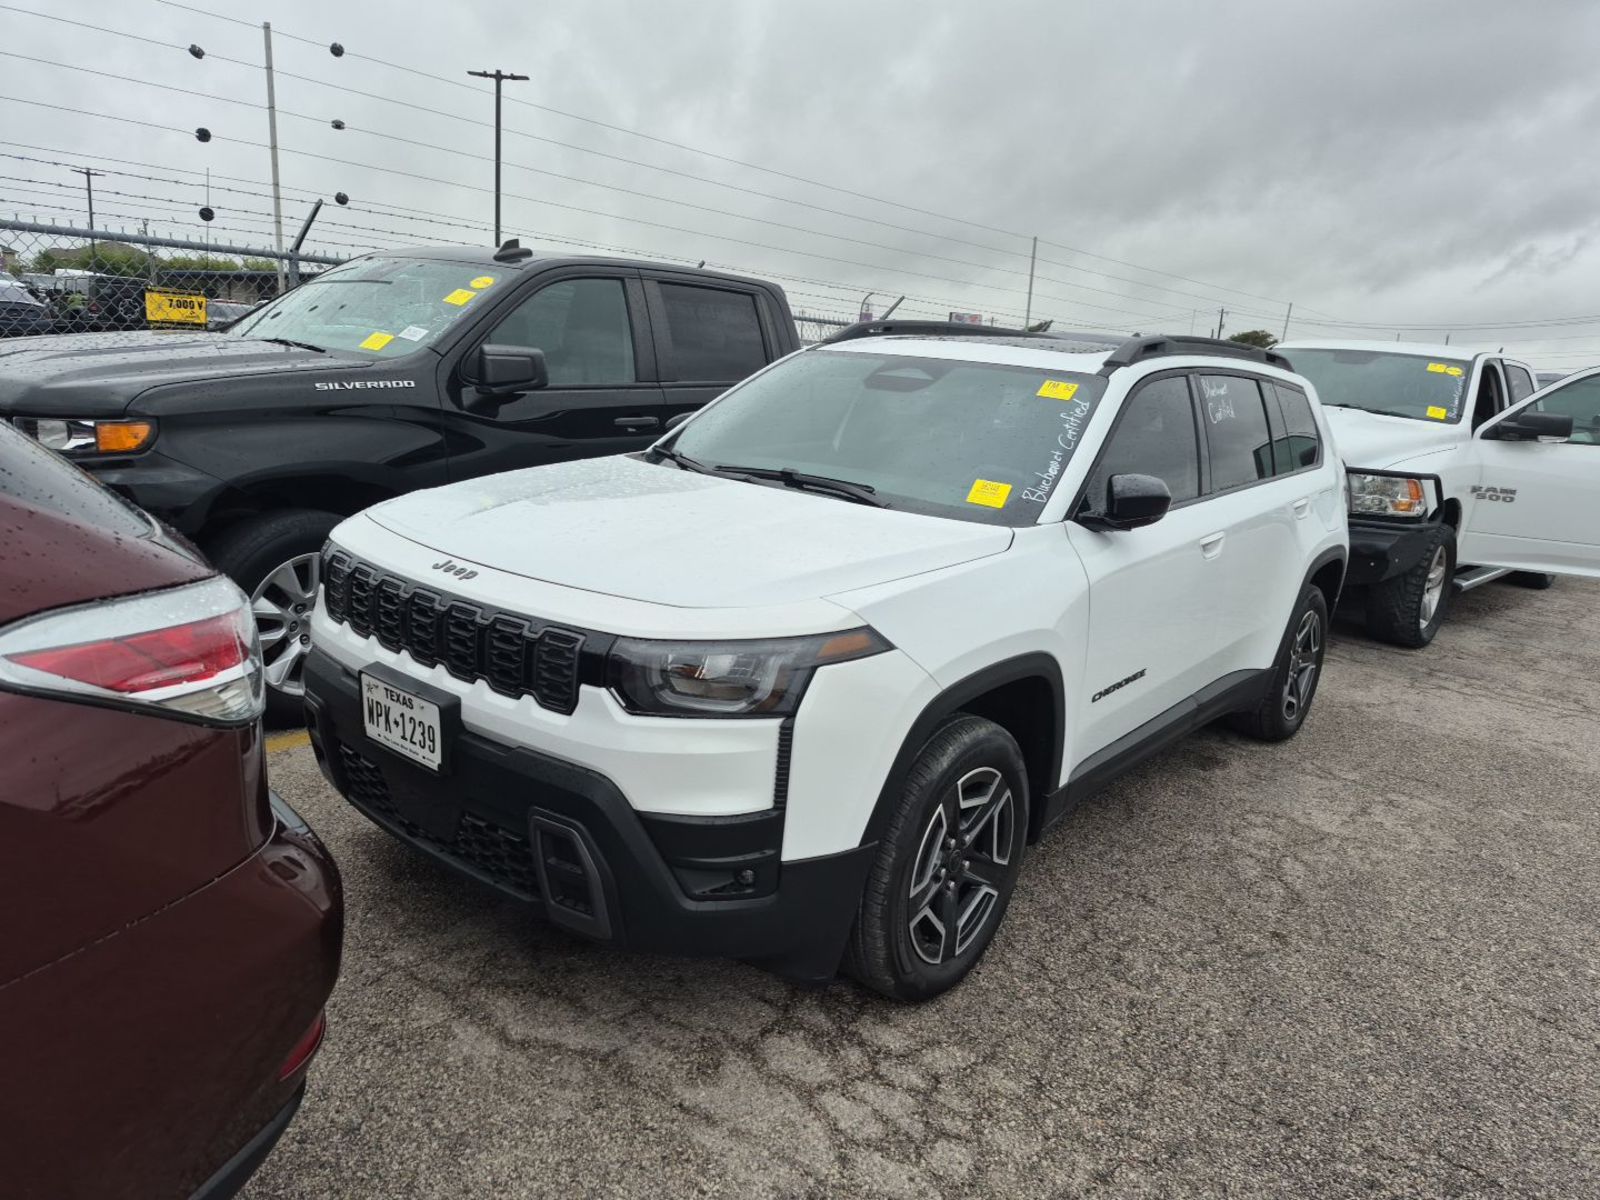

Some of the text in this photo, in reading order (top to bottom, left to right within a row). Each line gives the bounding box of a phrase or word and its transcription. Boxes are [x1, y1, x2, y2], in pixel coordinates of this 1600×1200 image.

[314, 380, 416, 391] SILVERADO
[1058, 398, 1090, 450] Certified
[1470, 485, 1517, 496] RAM
[431, 559, 479, 581] Jeep
[383, 686, 414, 710] TEXAS
[399, 711, 436, 755] 1239
